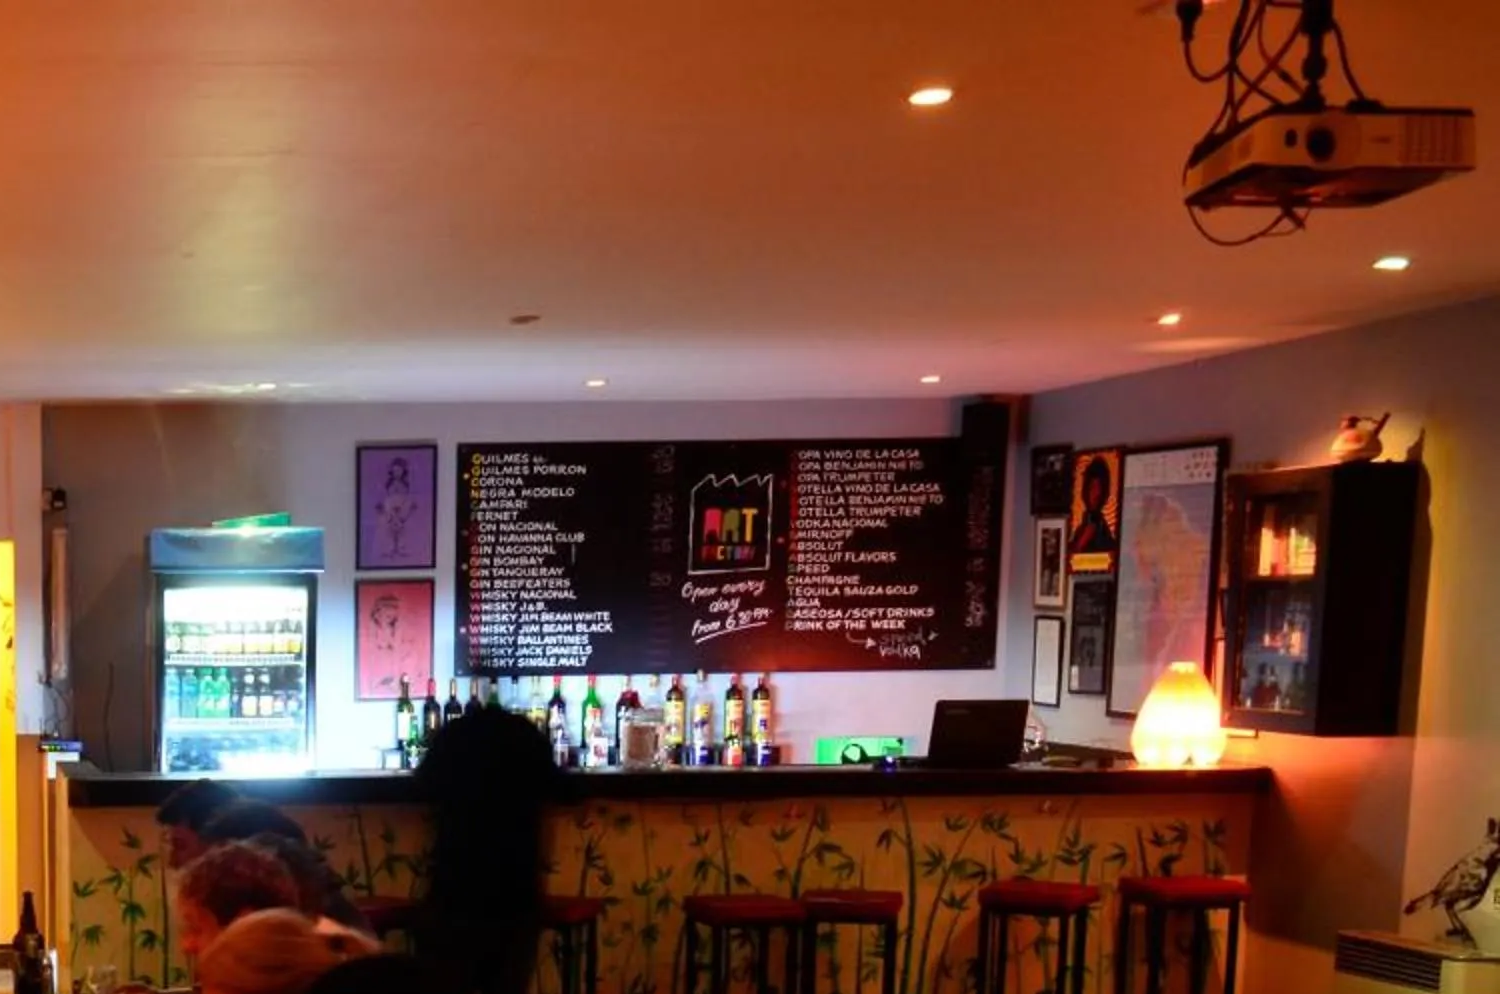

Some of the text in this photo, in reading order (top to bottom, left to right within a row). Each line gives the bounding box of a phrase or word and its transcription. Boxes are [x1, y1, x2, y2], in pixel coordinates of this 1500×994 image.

[472, 453, 529, 464] QUILMES
[792, 449, 920, 459] OPA VINO DE LA CASA
[472, 464, 587, 476] QUILMES PORRON
[792, 461, 821, 471] OPA
[471, 477, 523, 487] CORONA
[792, 472, 895, 482] OPA TRUMPETER
[471, 487, 575, 498] NEGRA MODELO
[793, 483, 940, 494] OTELLA VINO DE LA CASA
[470, 500, 528, 509] CAMPARI
[793, 495, 845, 505] OTELLA
[470, 511, 518, 520] FERNET
[793, 506, 921, 517] OTELLA TRUMPETER
[500, 522, 558, 532] NACIONAL
[704, 508, 758, 543] ART
[832, 518, 888, 529] NACIONAL
[555, 532, 585, 542] CLUB
[470, 544, 556, 554] GIN NACIONAL
[789, 541, 844, 550] ABSOLUT
[470, 556, 545, 566] GIN BOMBAY
[789, 552, 897, 562] ABSOLUT FLAVORS
[470, 567, 564, 577] GIN TANQUERAY
[787, 564, 830, 574] SPEED
[469, 578, 571, 589] GIN BEEFEATERS
[786, 575, 861, 585] CHAMPAGNE
[470, 590, 577, 600] WHISKY NACIONAL
[682, 581, 719, 602] Open
[787, 585, 919, 596] TEQUILA SAUZA GOLD
[470, 602, 517, 611] WHISKY
[709, 597, 741, 613] day
[470, 613, 517, 623] WHISKY
[541, 612, 572, 622] BEAM
[573, 611, 611, 621] WHITE
[887, 607, 935, 618] DRINKS
[469, 622, 613, 634] WHISKY JIM BEAM BLACK
[691, 618, 721, 636] from
[785, 619, 906, 631] DRINK OF THE WEEK
[469, 634, 589, 645] WHISKY BALLANTINES
[516, 646, 543, 656] JACK
[545, 645, 593, 656] DANIELS
[517, 657, 557, 667] SINGLE
[557, 656, 588, 666] MALT
